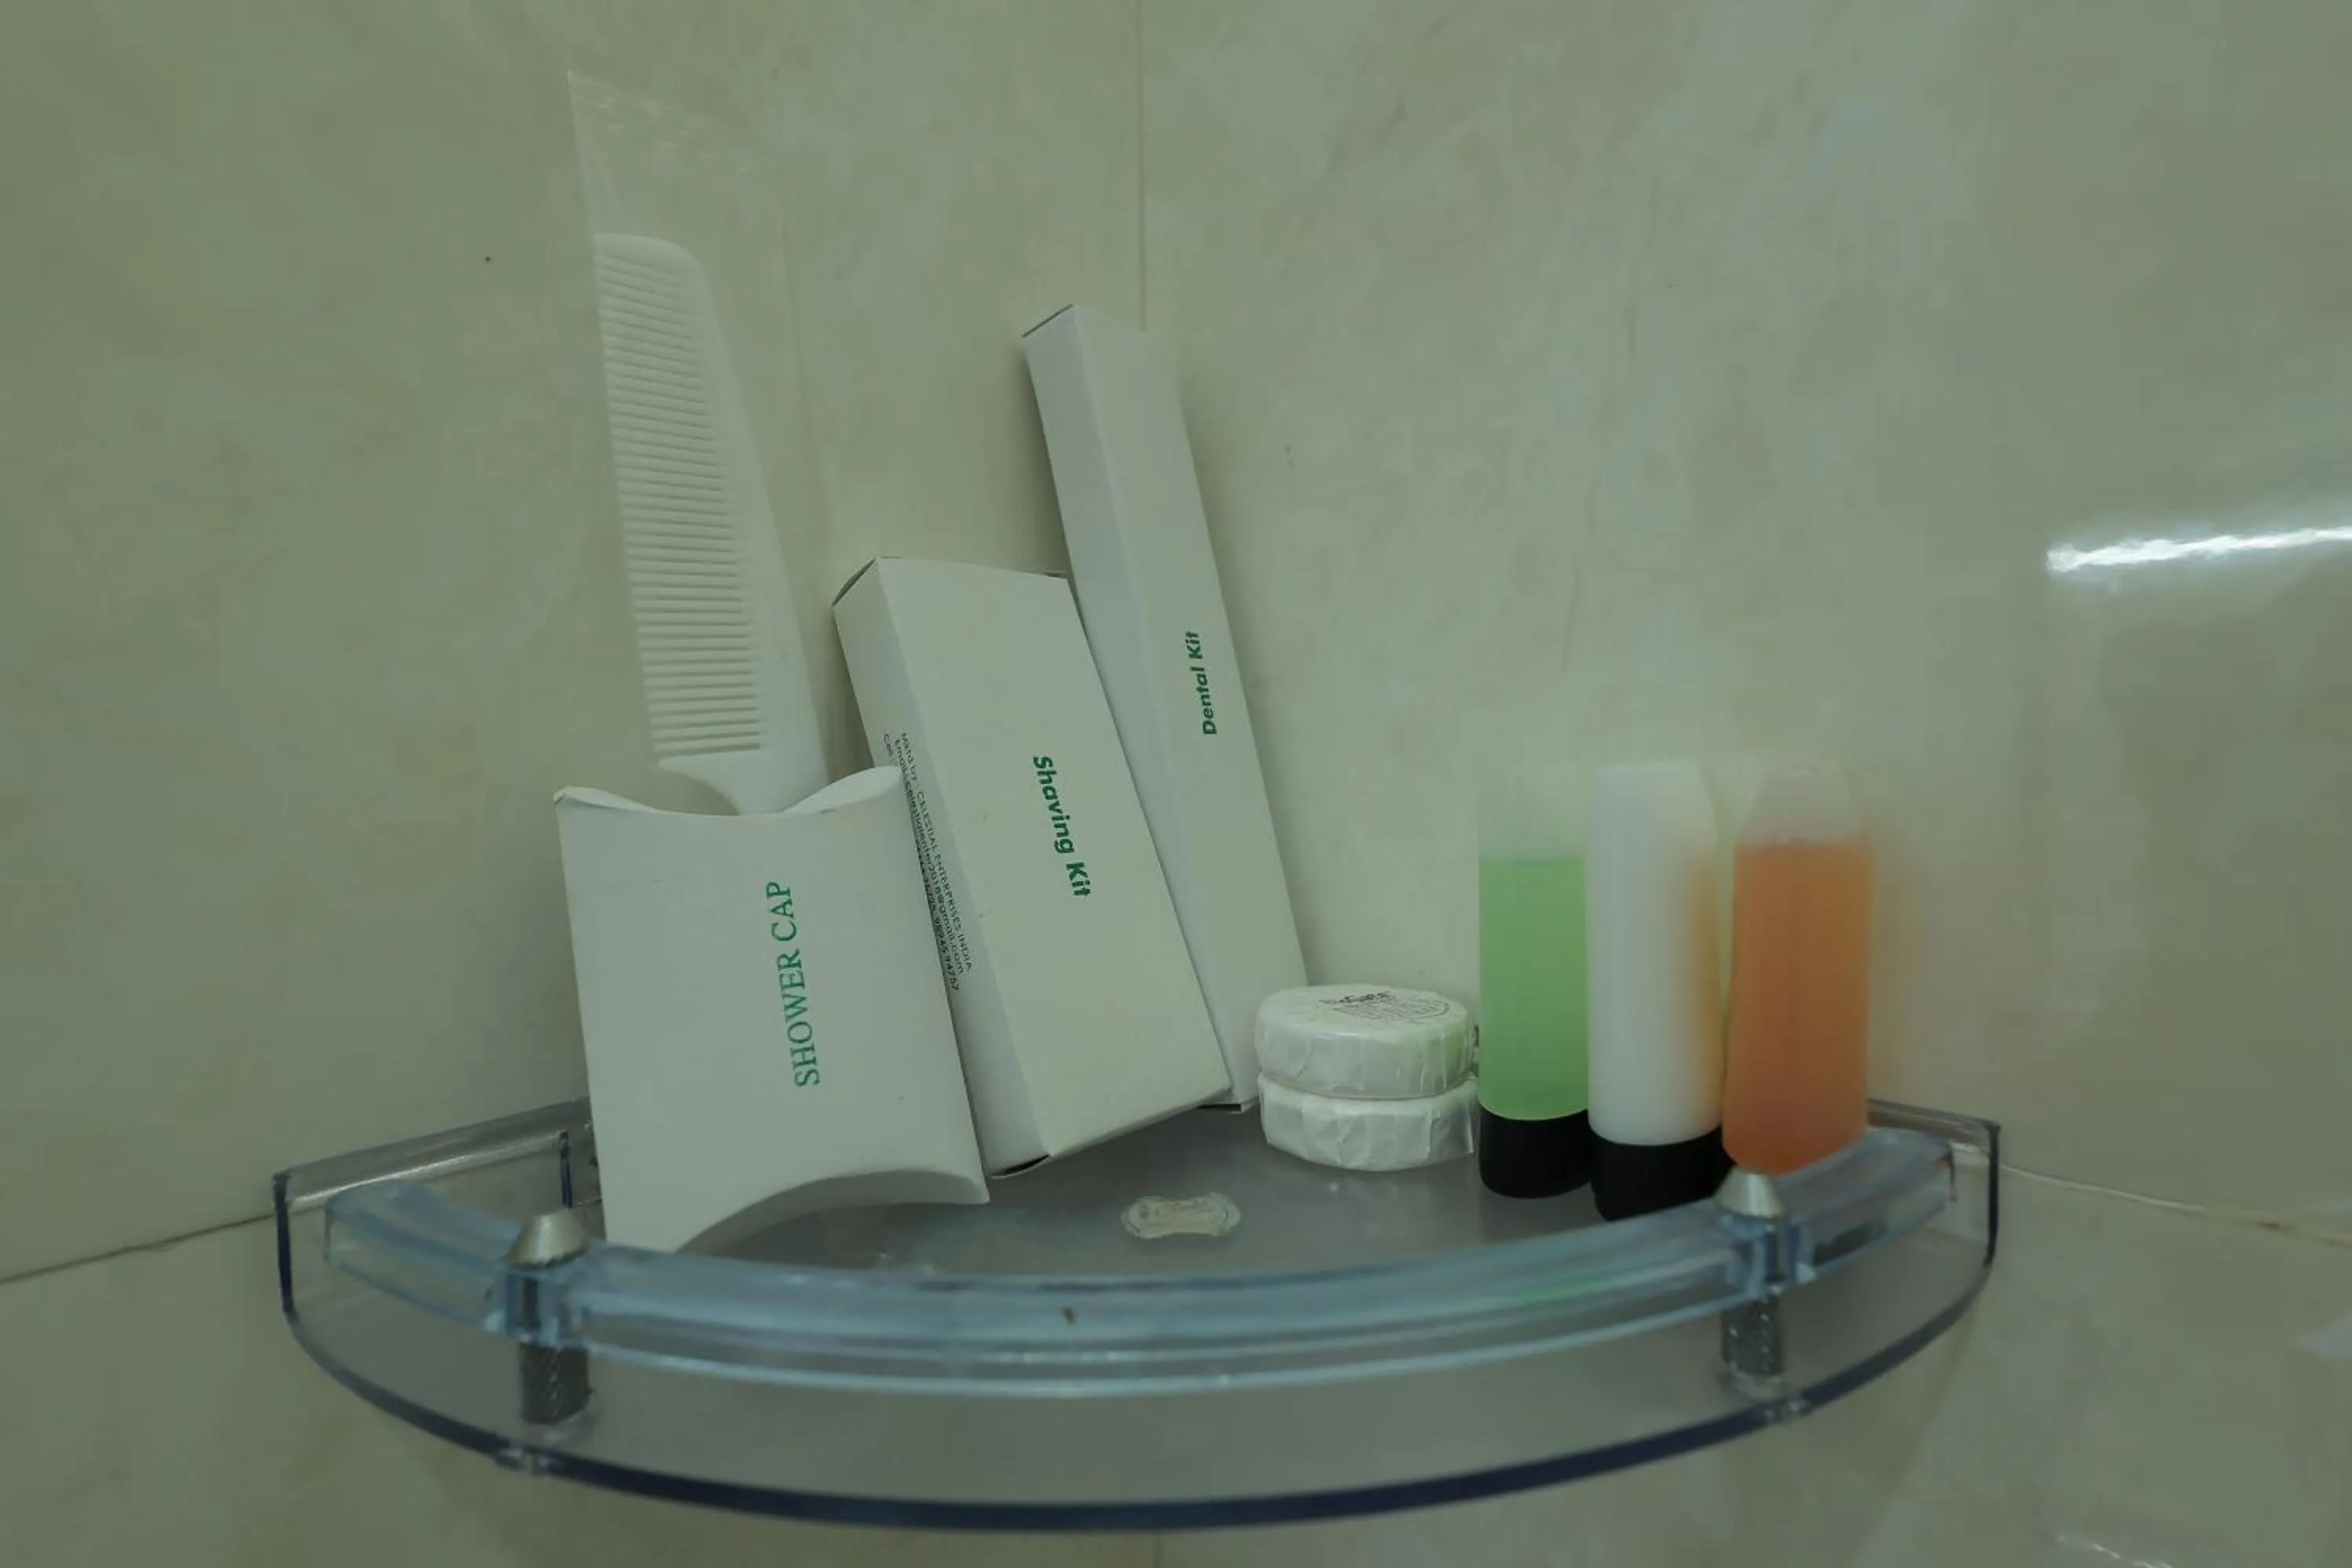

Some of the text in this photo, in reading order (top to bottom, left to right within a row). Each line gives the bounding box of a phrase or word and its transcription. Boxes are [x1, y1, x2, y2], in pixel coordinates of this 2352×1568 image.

[1185, 631, 1217, 735] Dental Kit
[916, 791, 938, 854] CELESTIAL
[934, 854, 962, 931] ENTERPRISES
[957, 934, 972, 972] INDIA
[1033, 756, 1091, 896] Shaving Kit
[765, 881, 820, 1087] SHOWER CAP
